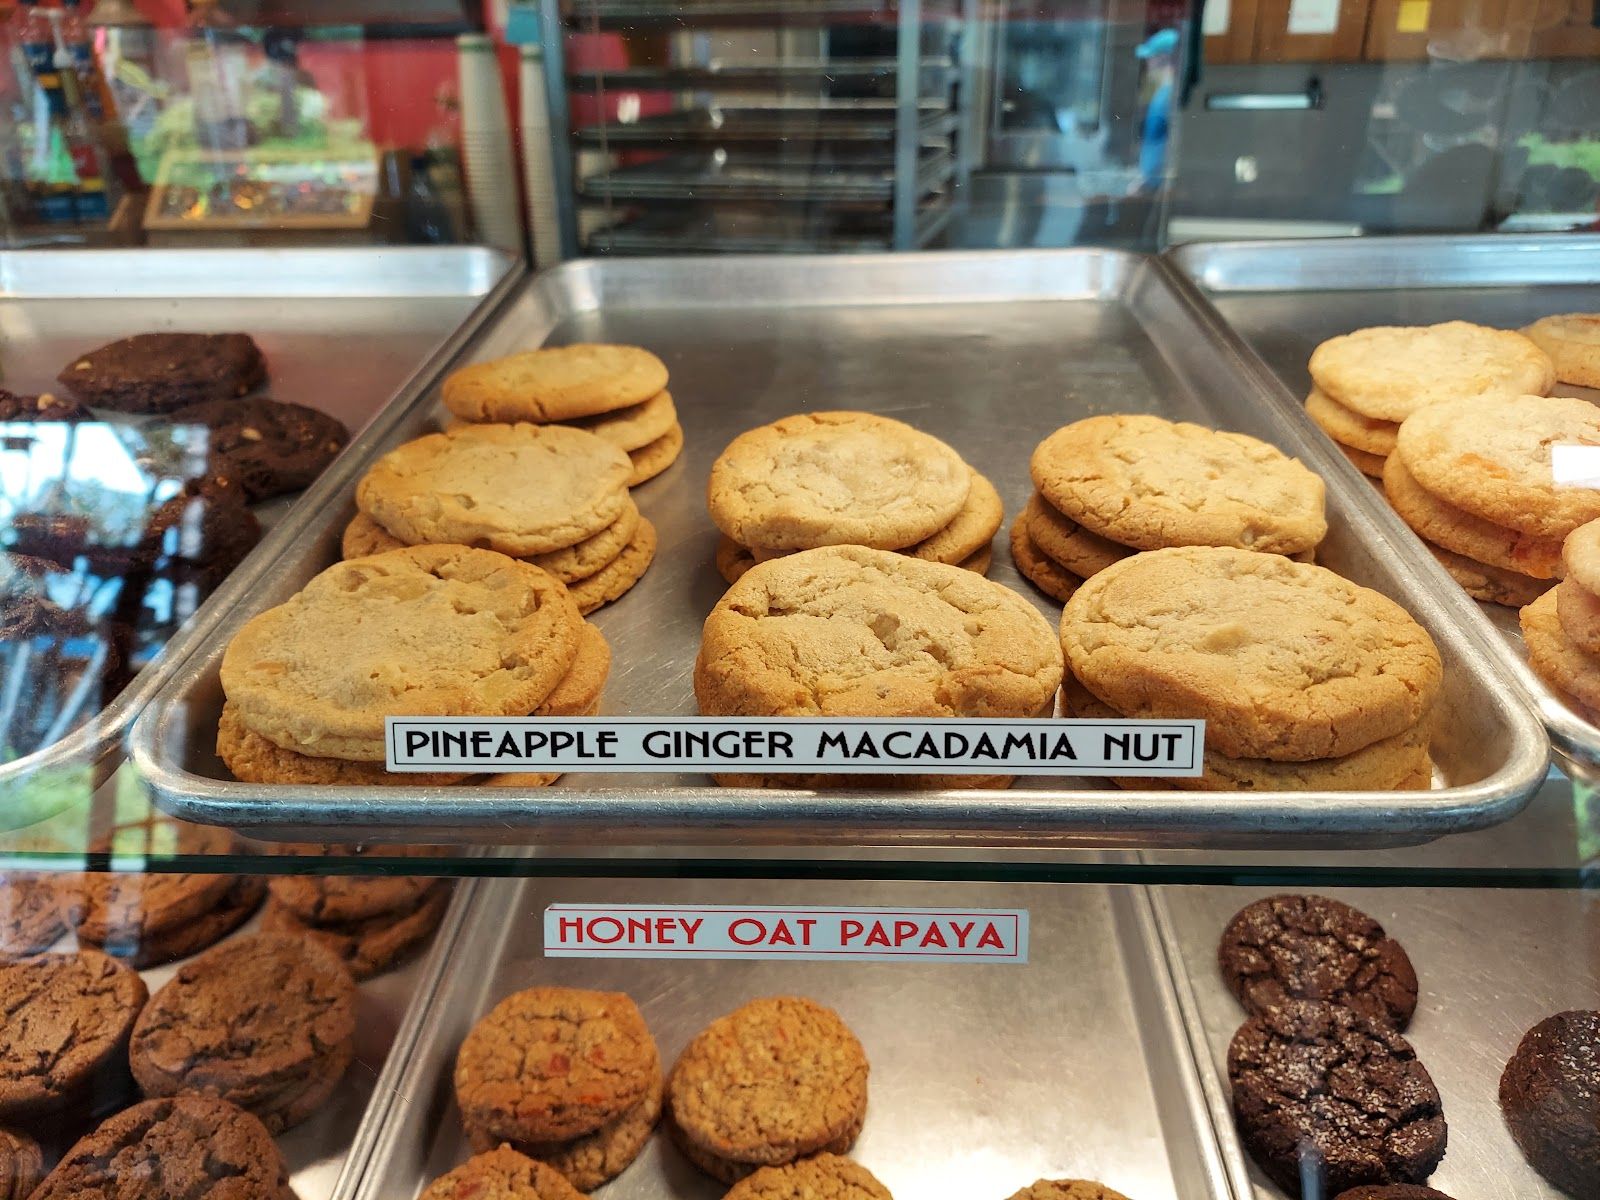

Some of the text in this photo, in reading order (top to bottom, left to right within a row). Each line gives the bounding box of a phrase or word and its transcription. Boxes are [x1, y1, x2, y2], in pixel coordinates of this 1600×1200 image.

[405, 730, 1183, 761] PINEAPPLE GINGER MACADAMIA NUT
[559, 917, 1006, 949] HONEY OAT PAPAYA
